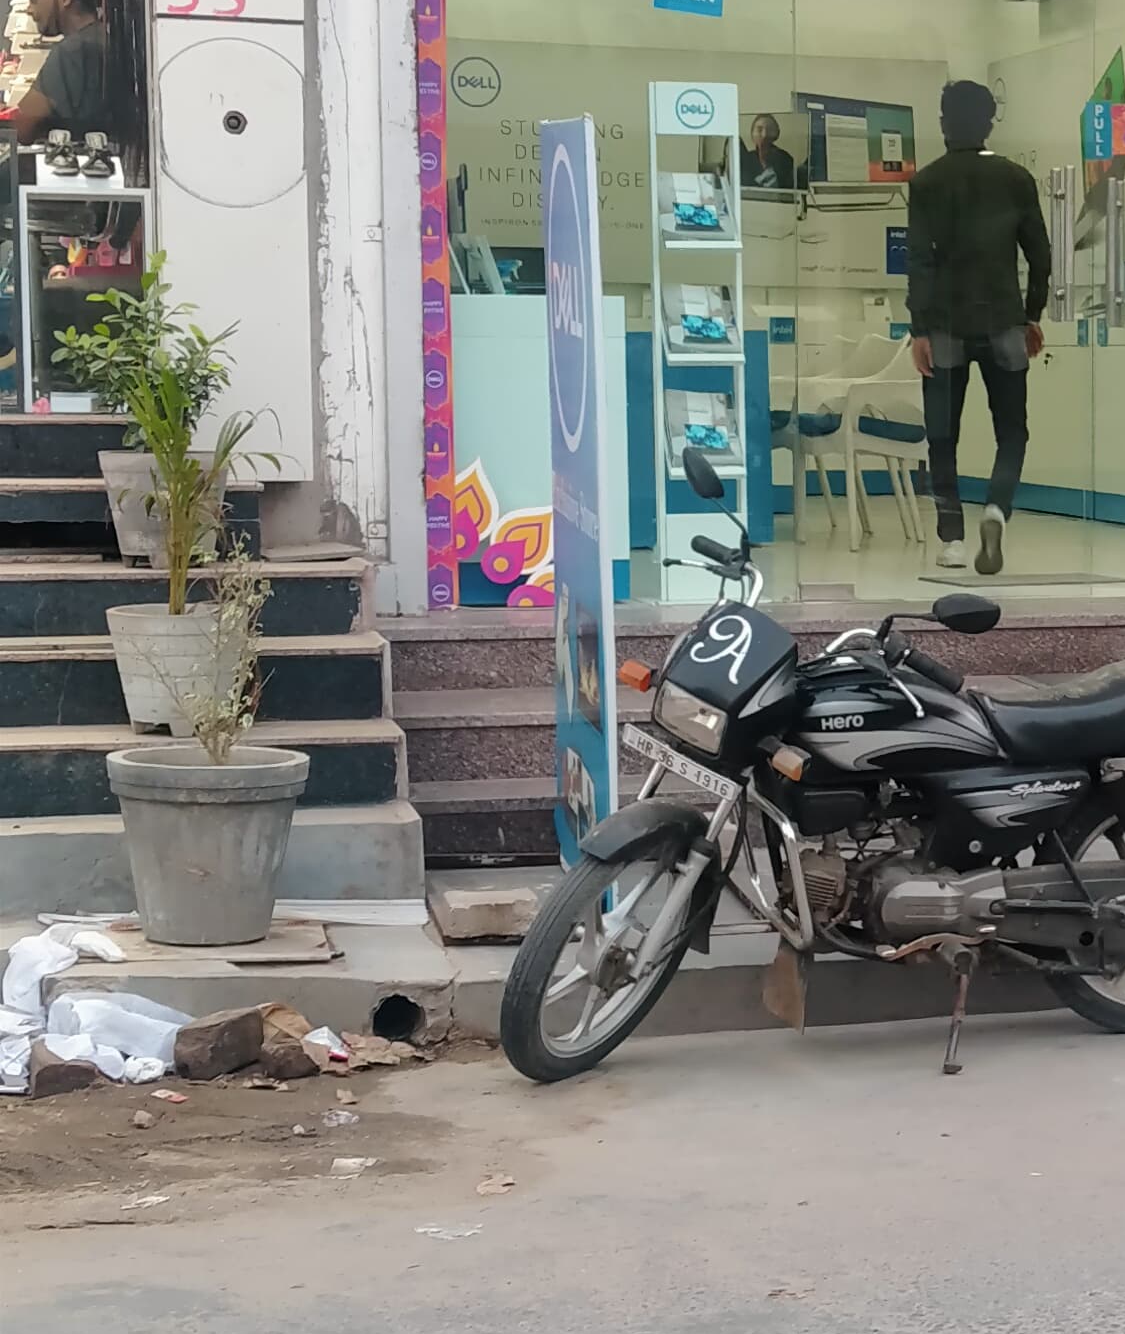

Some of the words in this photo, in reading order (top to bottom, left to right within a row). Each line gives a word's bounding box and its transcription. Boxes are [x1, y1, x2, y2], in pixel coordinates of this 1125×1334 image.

[457, 75, 497, 90] DELL
[680, 103, 711, 116] DELL
[1094, 104, 1105, 156] PULL
[637, 736, 654, 753] HR
[657, 750, 674, 768] 36
[679, 763, 688, 776] S
[694, 770, 731, 796] 1916
